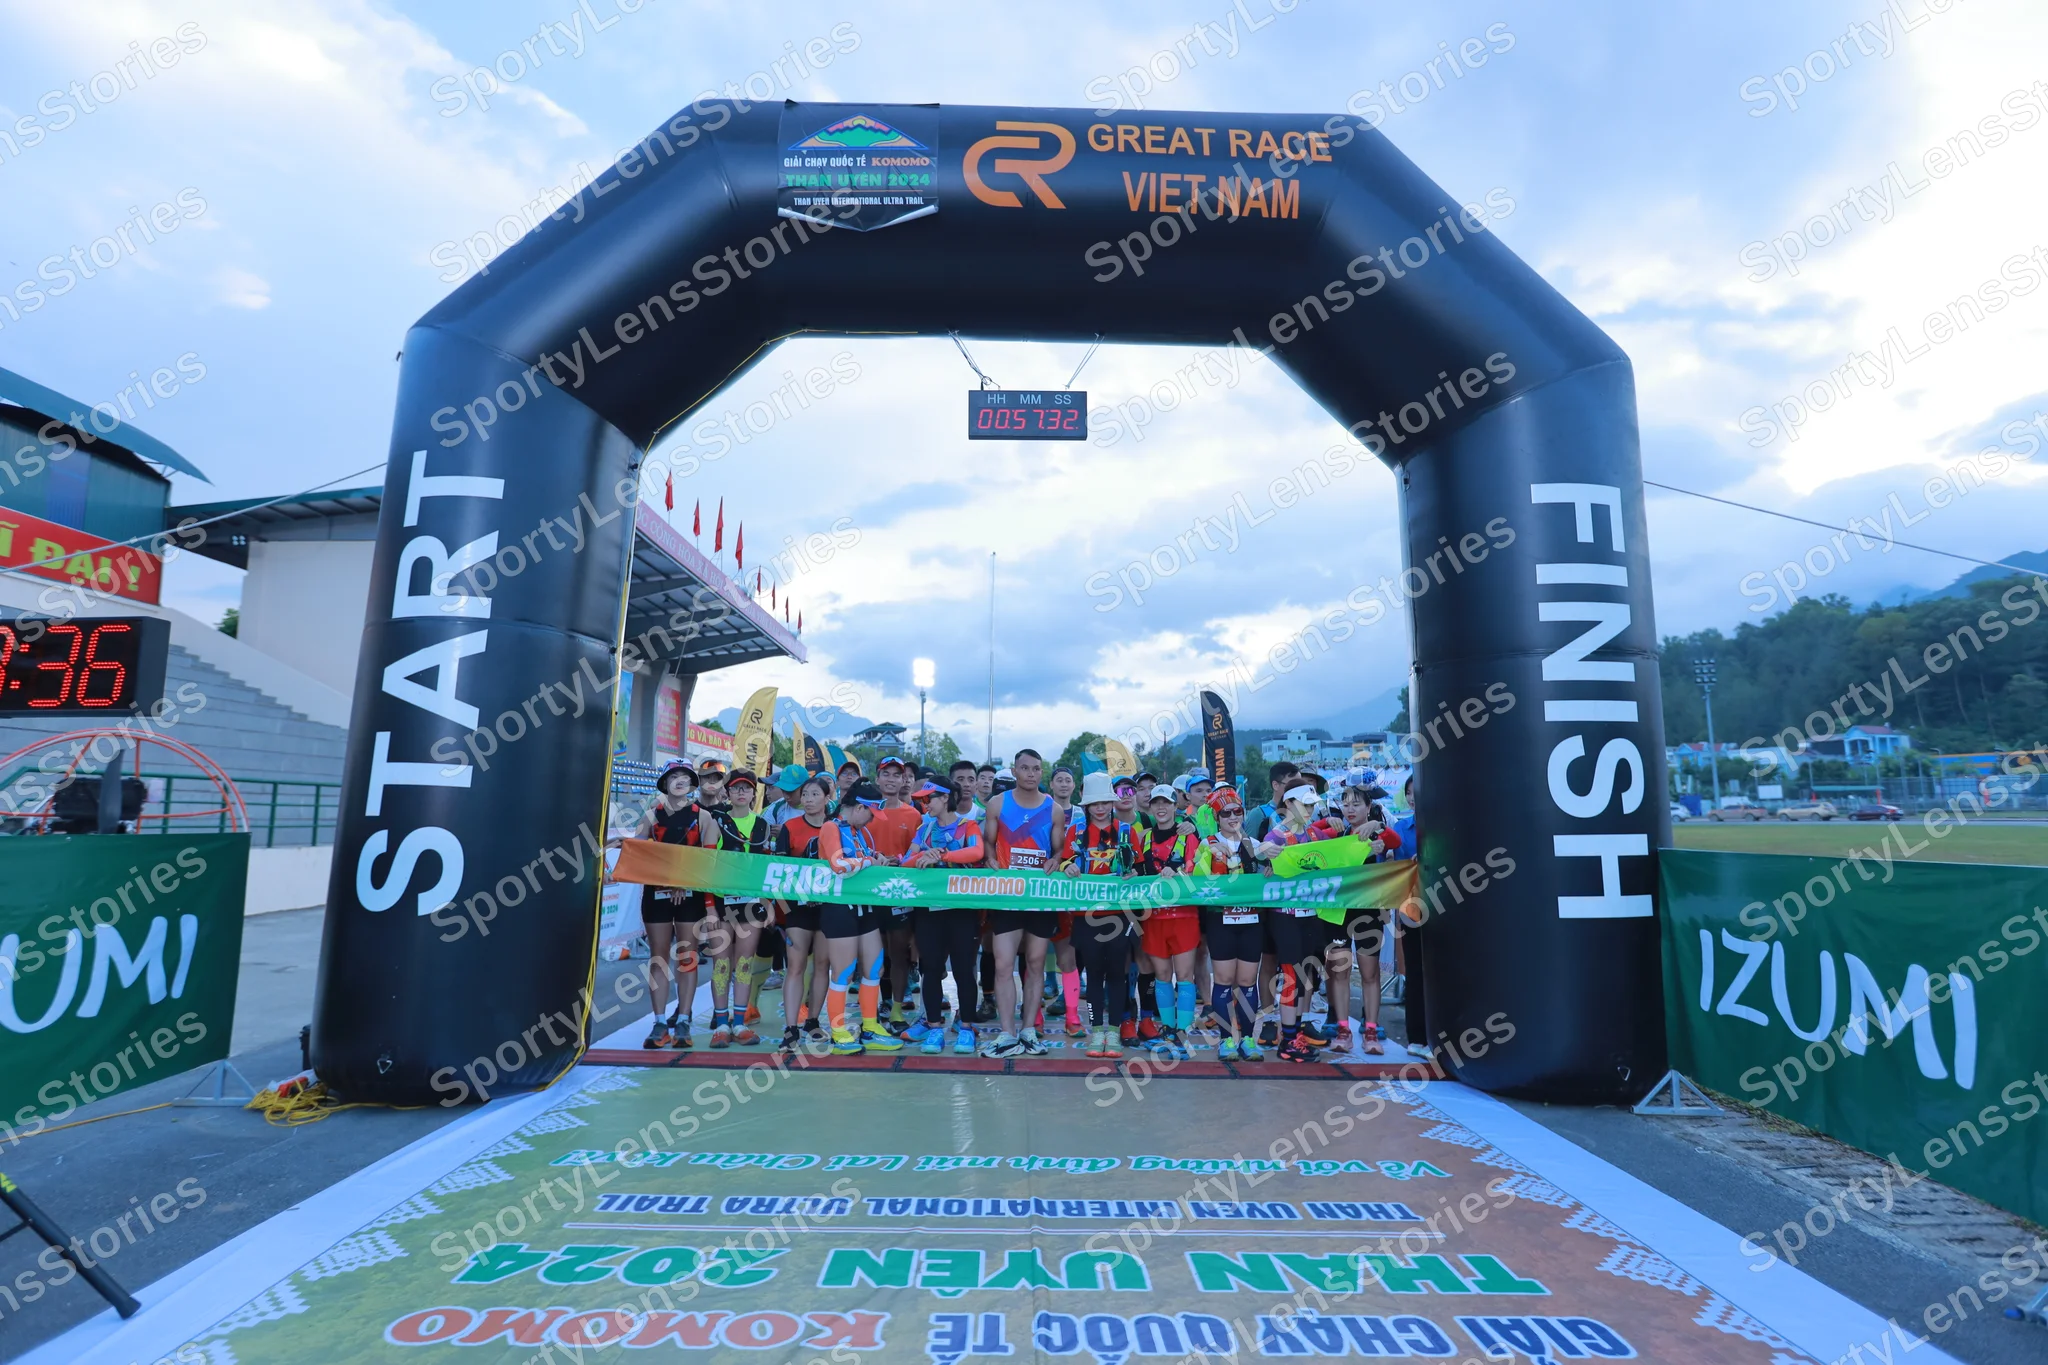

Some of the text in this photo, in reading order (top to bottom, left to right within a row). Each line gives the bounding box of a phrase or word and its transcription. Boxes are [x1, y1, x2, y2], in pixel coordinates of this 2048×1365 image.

[1087, 123, 1333, 162] GREAT RACE
[784, 154, 931, 169] GIẢI CHẠY QUỐC TẾ KOMOMO
[786, 172, 931, 187] THAN UYÊN 2024
[1122, 171, 1299, 219] VIET NAM
[831, 197, 882, 205] INTERNATIONAL
[883, 197, 904, 205] ULTRA
[905, 196, 924, 205] TRAIL
[987, 394, 1072, 405] HH MM SS
[29, 537, 113, 584] ĐẠI
[356, 450, 505, 917] START
[1531, 483, 1653, 919] FINISH
[1017, 855, 1040, 866] 2506
[762, 862, 846, 897] START
[947, 875, 1163, 901] KOMOMO THAN UYEN 2024
[1699, 928, 1979, 1090] IZUMI
[688, 1150, 821, 1171] Châu
[824, 1153, 909, 1171] Lai
[1129, 1155, 1289, 1177] những
[1298, 1159, 1375, 1178] với
[1376, 1159, 1454, 1180] Về
[595, 1193, 1428, 1222] THAN UYEN INTERNATIONAL ULTRA TRAIL
[450, 1242, 1552, 1299] THAN UYÊN 2024
[384, 1304, 892, 1350] KOMOMO
[924, 1312, 1014, 1365] TẾ
[1032, 1310, 1239, 1365] QUỐC
[1253, 1307, 1458, 1359] CHẠY
[1454, 1313, 1638, 1365] GIẢI
